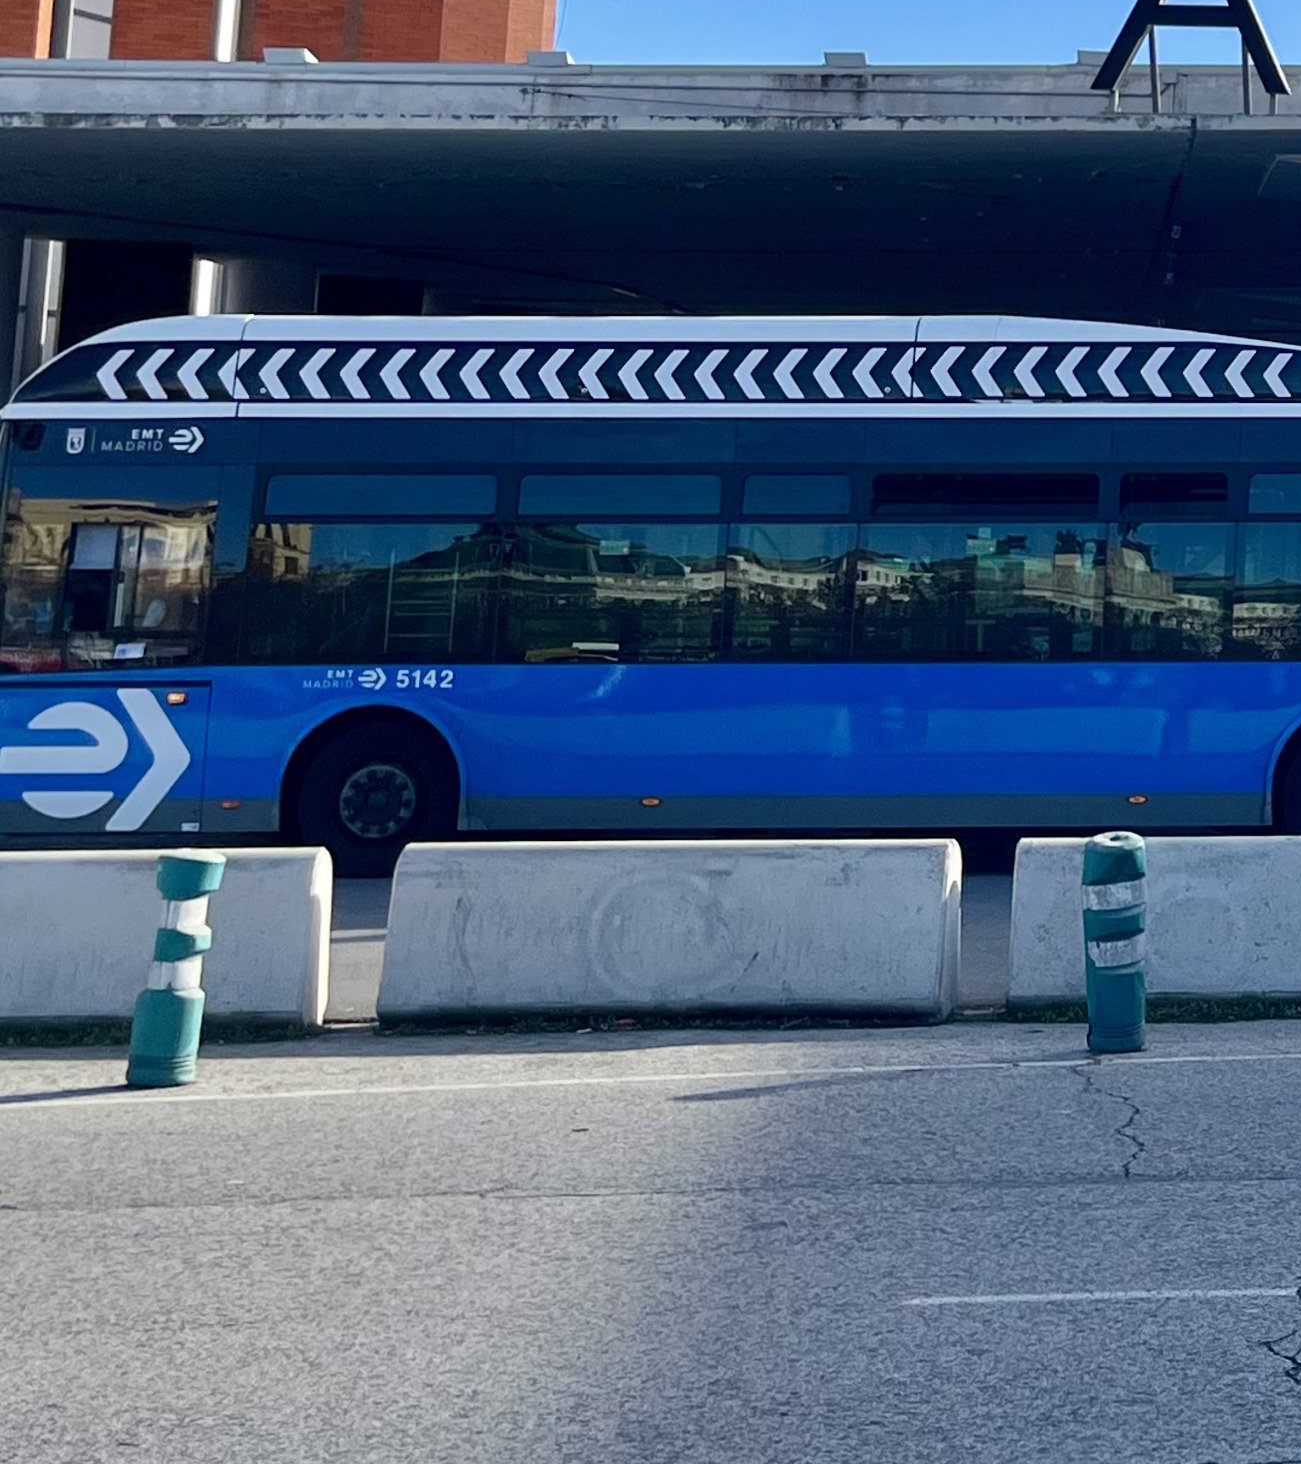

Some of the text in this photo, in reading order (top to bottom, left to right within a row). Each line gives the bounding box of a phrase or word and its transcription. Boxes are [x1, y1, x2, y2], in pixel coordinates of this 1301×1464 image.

[131, 428, 165, 440] EMT
[101, 440, 164, 452] MADRID
[327, 669, 354, 679] EMT
[396, 669, 454, 689] 5142
[303, 679, 354, 689] MADRID
